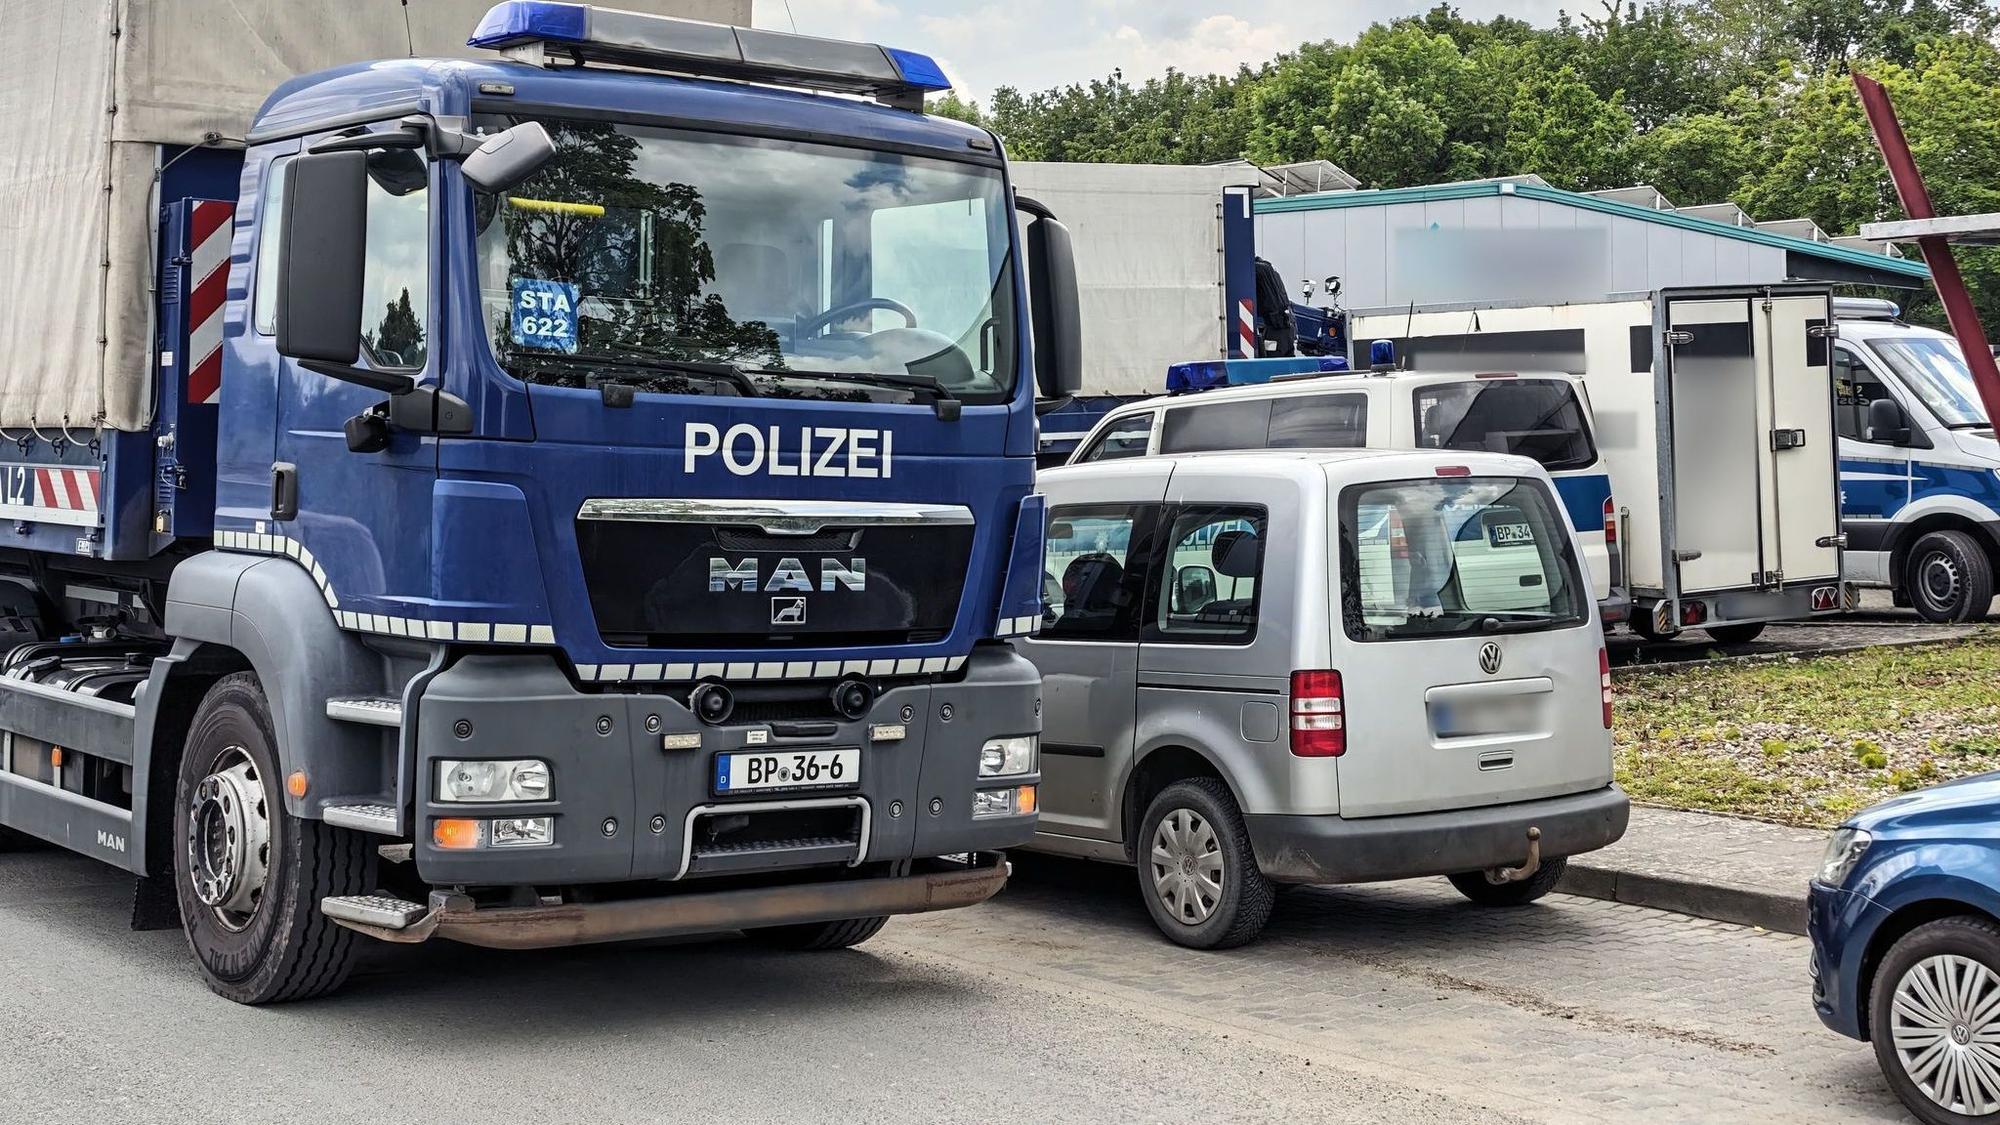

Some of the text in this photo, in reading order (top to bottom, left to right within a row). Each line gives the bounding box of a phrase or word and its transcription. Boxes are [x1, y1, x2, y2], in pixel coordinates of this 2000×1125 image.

[520, 290, 571, 312] STA
[522, 316, 568, 338] 622
[684, 422, 893, 478] POLIZEI
[1496, 526, 1512, 541] BP
[709, 558, 866, 591] MAN
[748, 757, 778, 784] BP
[792, 754, 844, 782] 36-6
[97, 829, 125, 853] MAN
